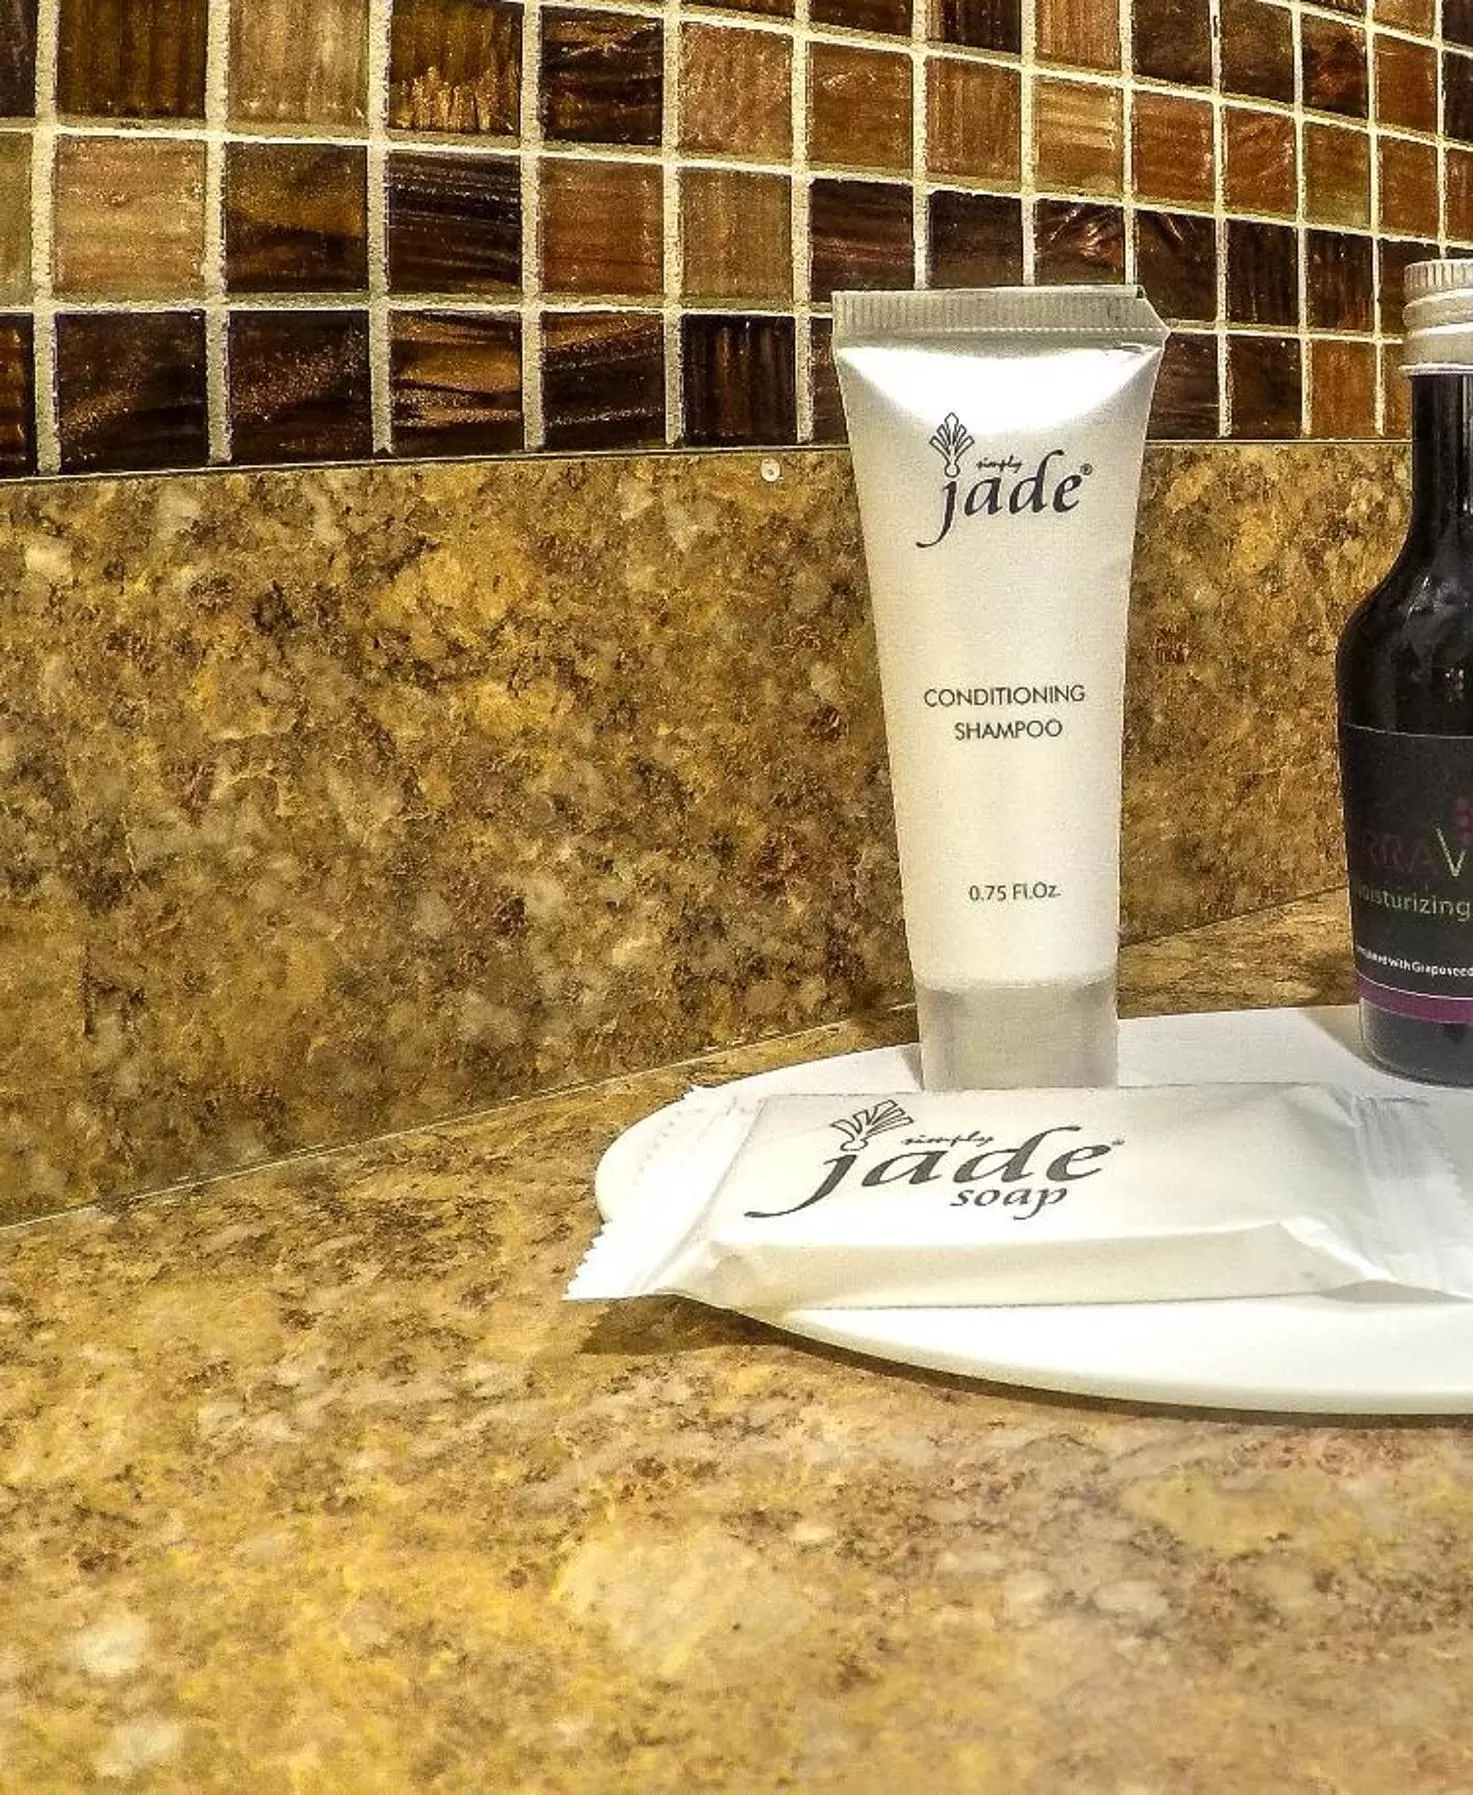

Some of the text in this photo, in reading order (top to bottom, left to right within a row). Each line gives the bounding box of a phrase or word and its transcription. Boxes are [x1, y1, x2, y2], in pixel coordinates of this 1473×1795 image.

[975, 455, 1022, 472] simply
[923, 684, 1086, 708] CONDITIONING
[954, 719, 1063, 741] SHAMPOO
[968, 884, 1007, 902] 0.75
[902, 1130, 995, 1148] simply
[950, 1186, 1068, 1220] soap
